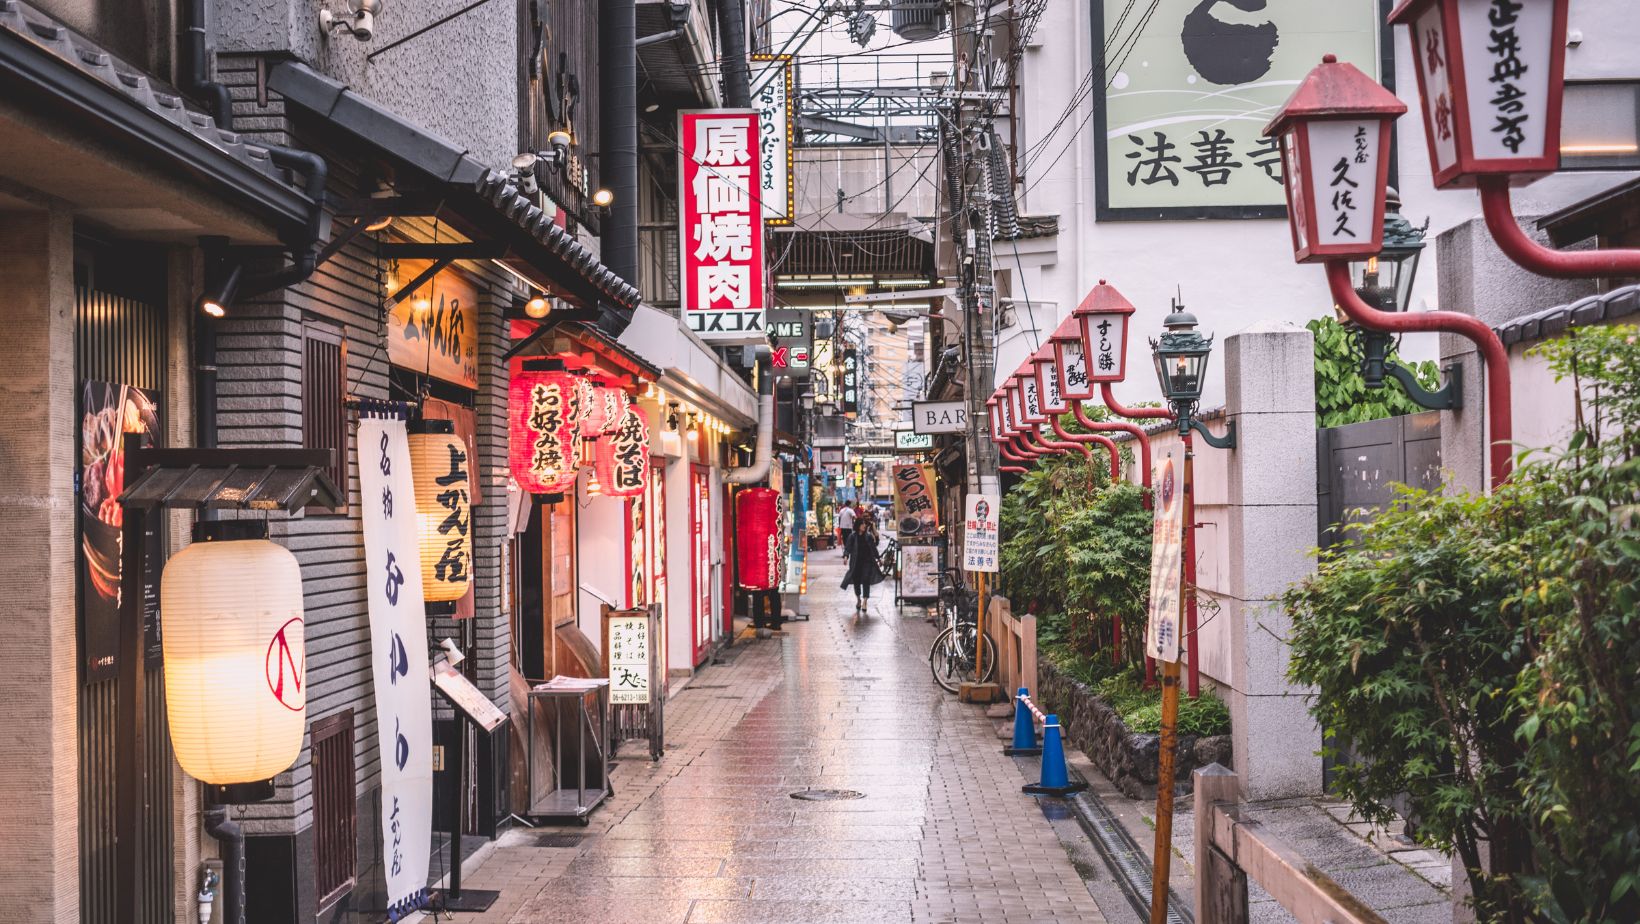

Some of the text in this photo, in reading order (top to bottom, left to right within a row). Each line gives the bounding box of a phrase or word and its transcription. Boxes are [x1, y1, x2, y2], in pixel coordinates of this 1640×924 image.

[1354, 126, 1369, 163] 上かん屋
[692, 118, 752, 310] 原価焼肉
[1330, 157, 1358, 238] 久佐久
[687, 312, 762, 332] コスコス
[1097, 320, 1115, 371] すし勝
[926, 409, 966, 425] BAR
[896, 467, 932, 514] もつ鍋
[434, 443, 470, 582] 上かん屋
[968, 555, 993, 567] 法善寺
[613, 623, 621, 660] 一品料理
[619, 668, 647, 688] 大たこ
